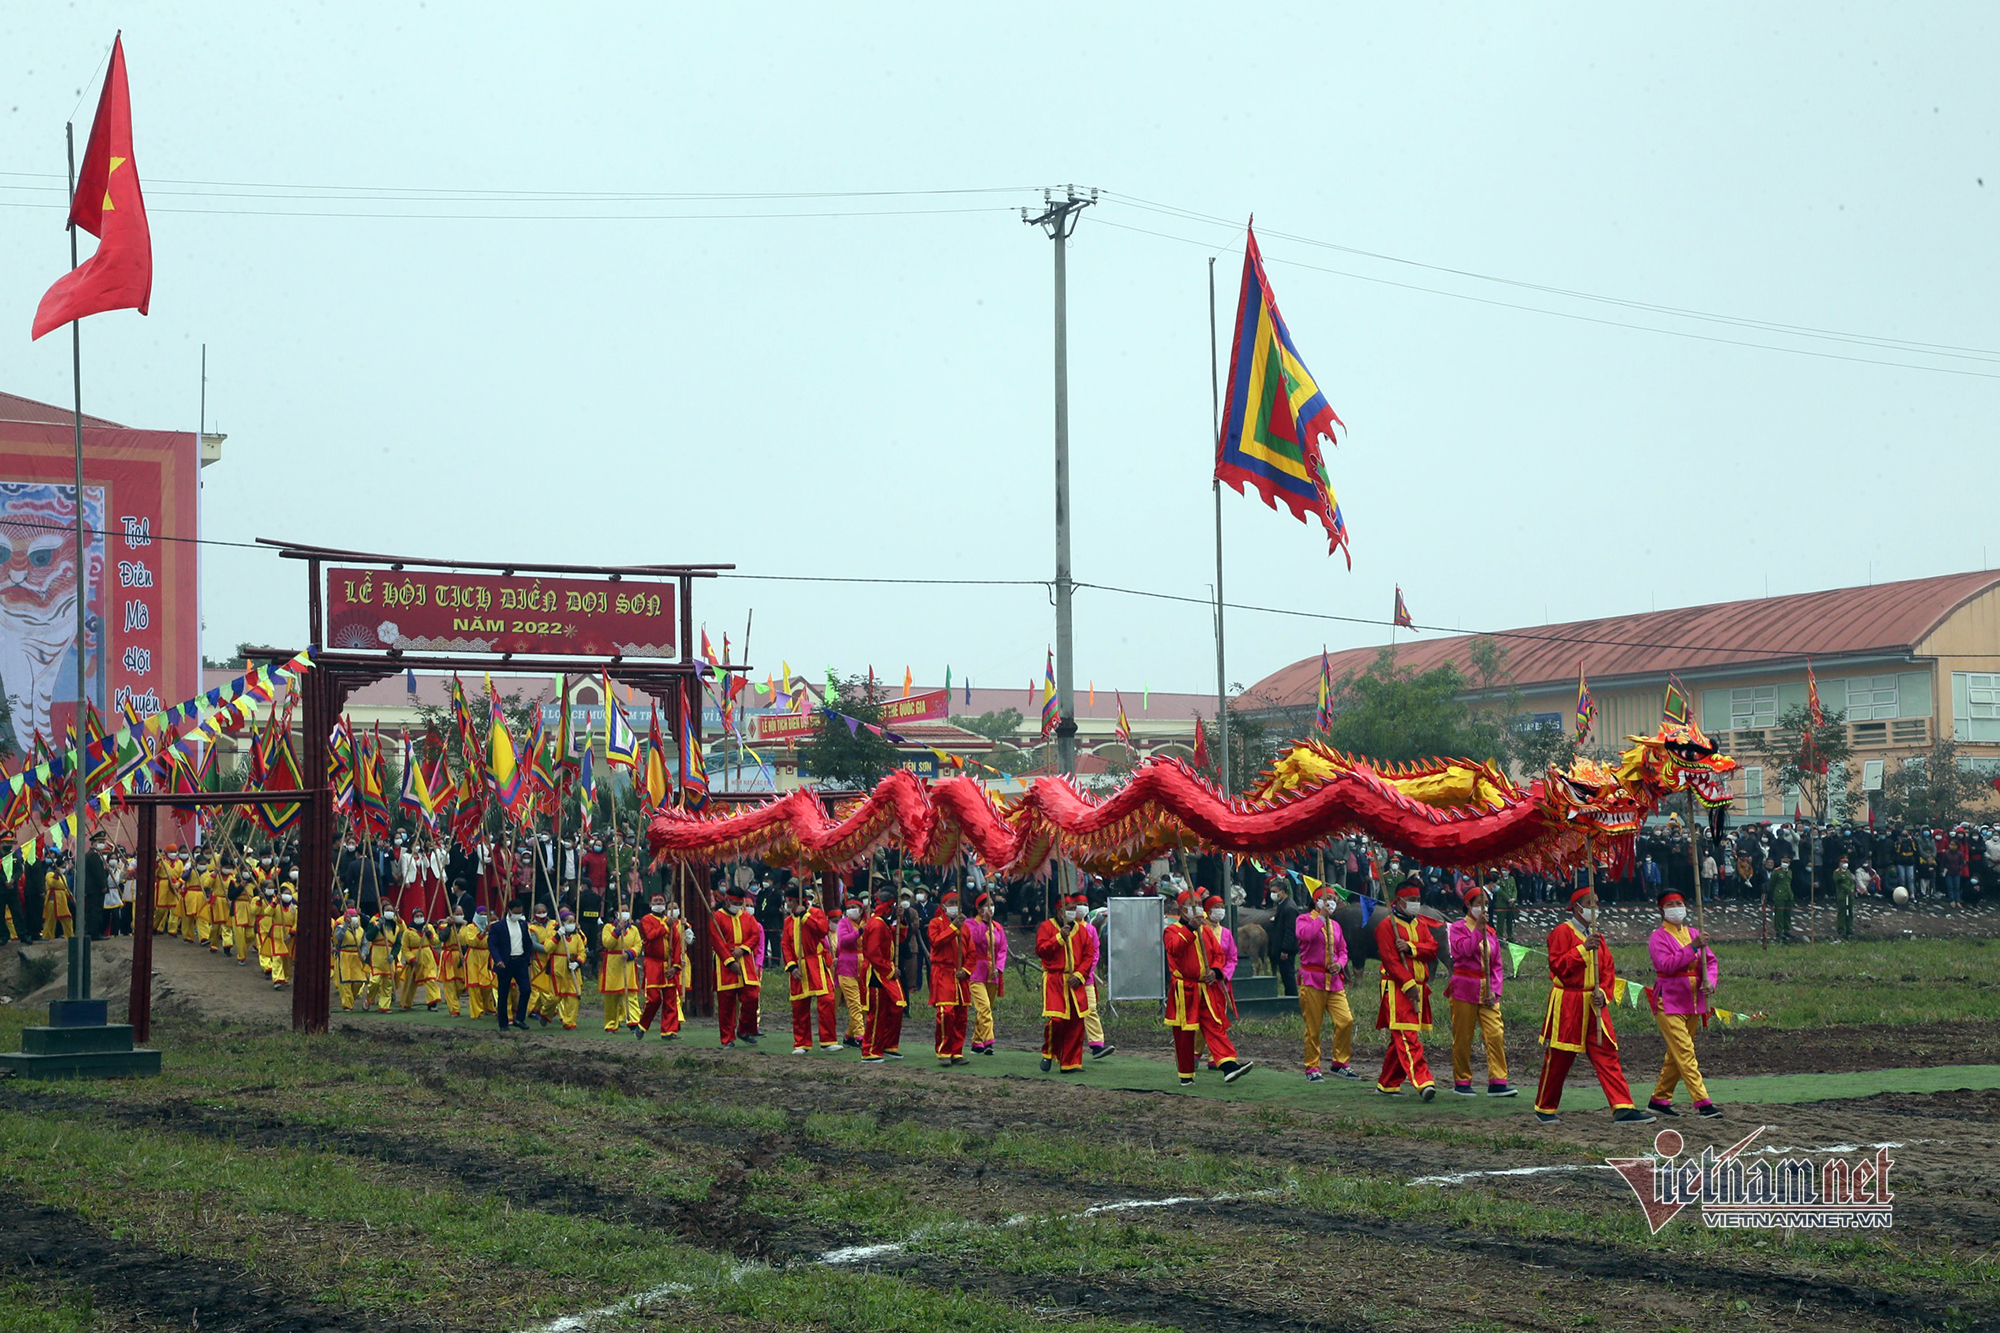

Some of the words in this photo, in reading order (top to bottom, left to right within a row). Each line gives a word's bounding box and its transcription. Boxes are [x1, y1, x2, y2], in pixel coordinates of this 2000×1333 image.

[120, 516, 151, 549] Tịch
[118, 561, 153, 588] Điền
[344, 571, 374, 604] LỄ
[382, 578, 427, 610] HỘI
[435, 584, 492, 612] TỊCH
[124, 599, 149, 633] Mở
[453, 615, 504, 632] NĂM
[512, 620, 563, 635] 2022
[123, 646, 151, 676] Hội
[571, 709, 586, 720] CH
[916, 700, 926, 714] GIA
